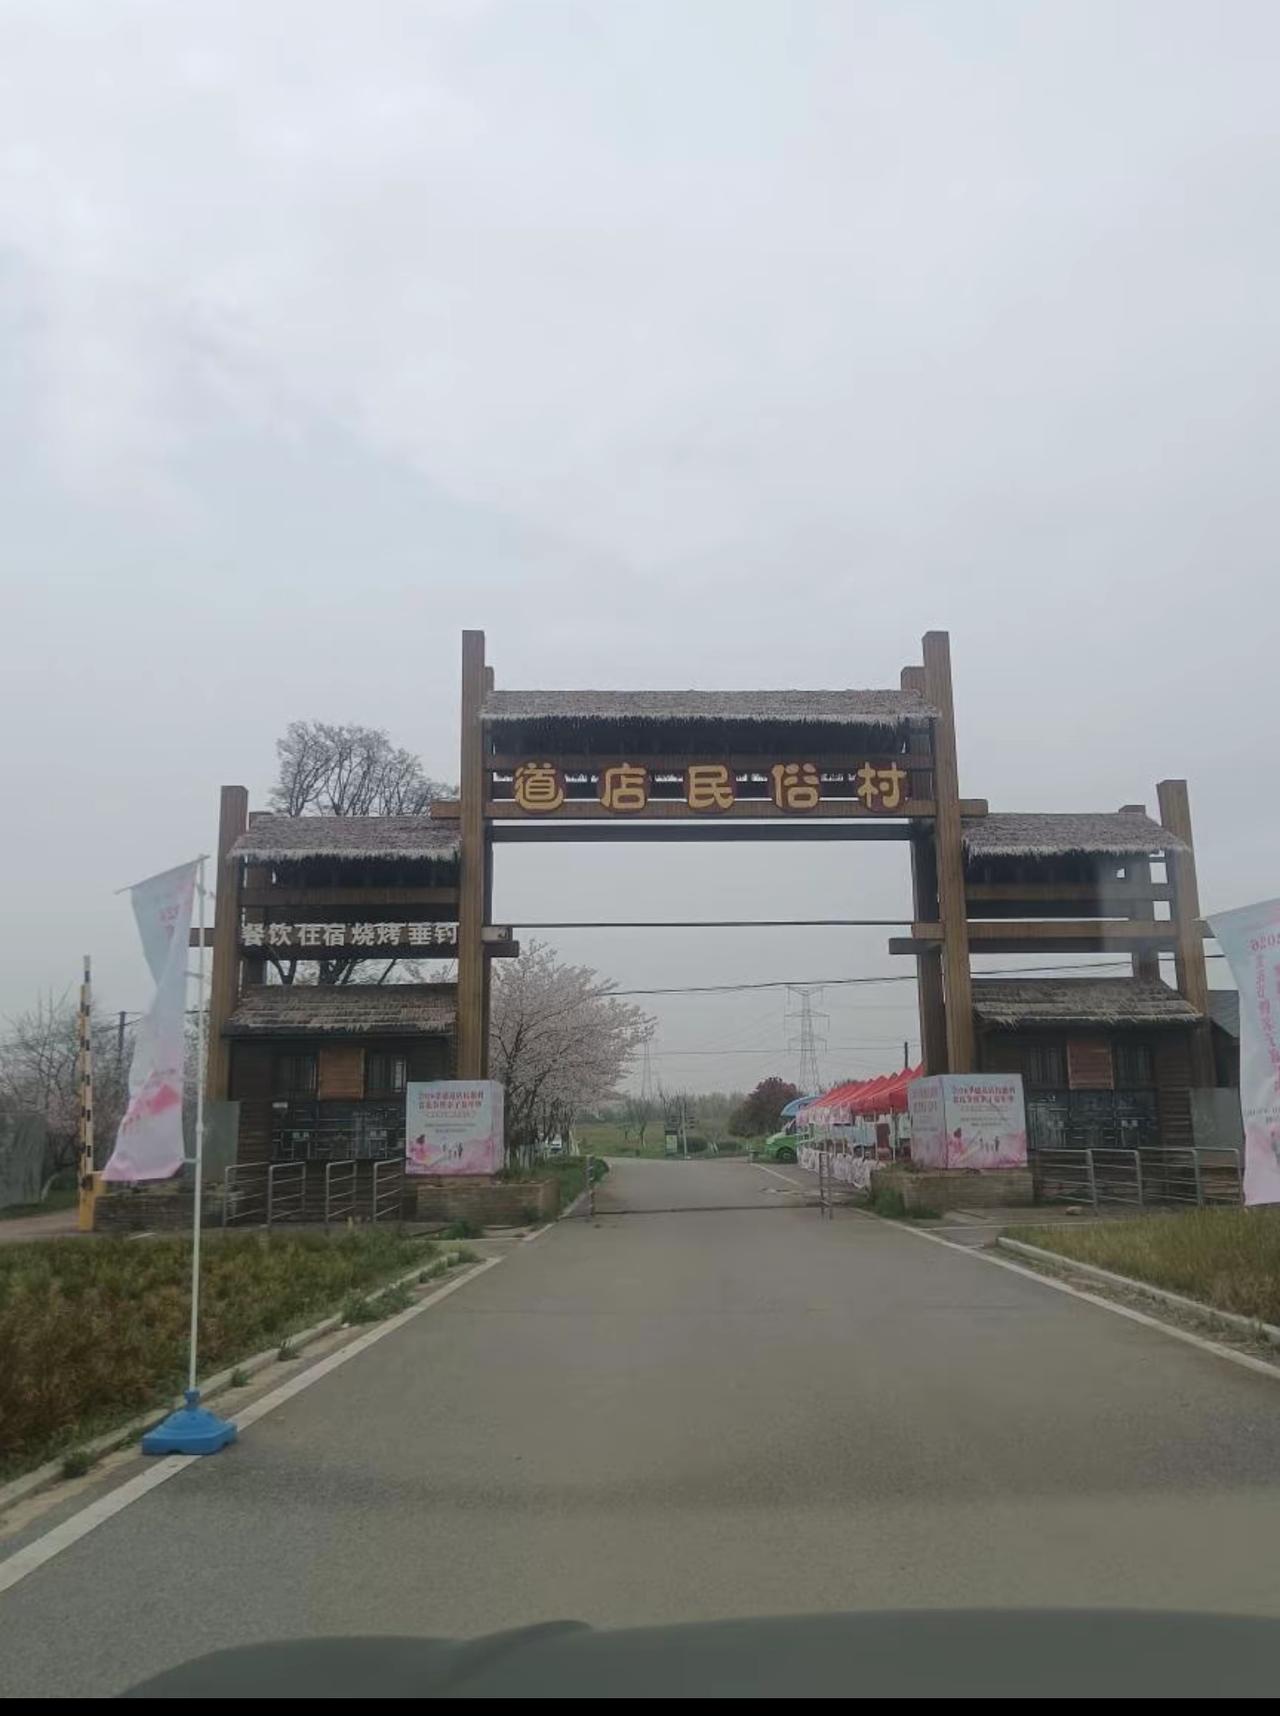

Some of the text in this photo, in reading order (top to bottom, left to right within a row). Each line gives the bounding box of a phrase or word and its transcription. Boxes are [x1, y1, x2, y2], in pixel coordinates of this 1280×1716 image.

[513, 761, 908, 811] 道店民俗村
[241, 922, 459, 946] 餐饮 住宿 烧烤 垂钓
